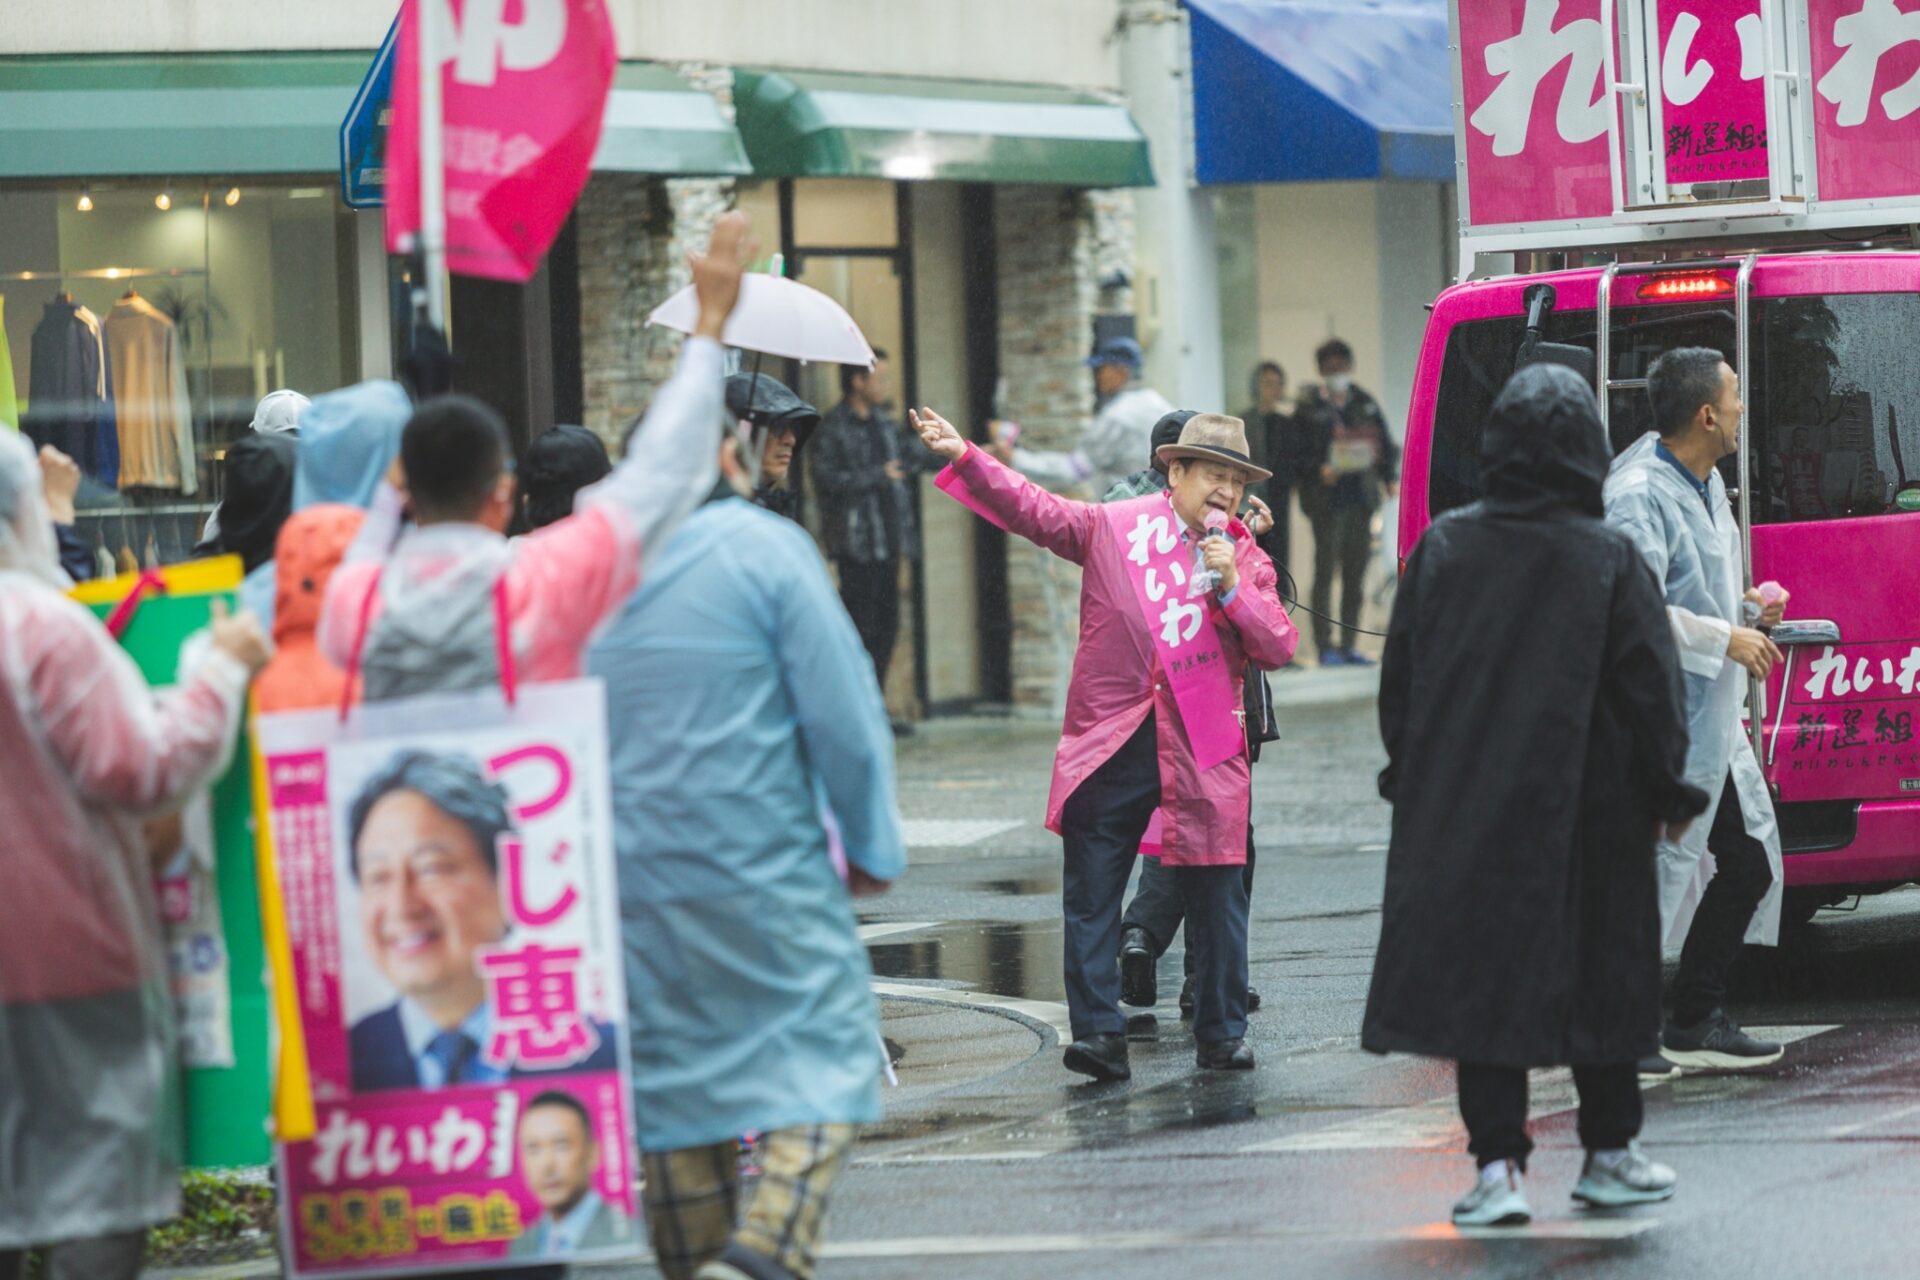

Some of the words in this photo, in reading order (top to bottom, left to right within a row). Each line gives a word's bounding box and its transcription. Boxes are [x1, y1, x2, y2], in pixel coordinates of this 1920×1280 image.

[1665, 121, 1757, 159] 新選組
[1126, 513, 1203, 649] れいわ
[1791, 706, 1914, 752] 新選組
[482, 743, 588, 1062] つじ恵
[309, 1106, 487, 1185] れいわ
